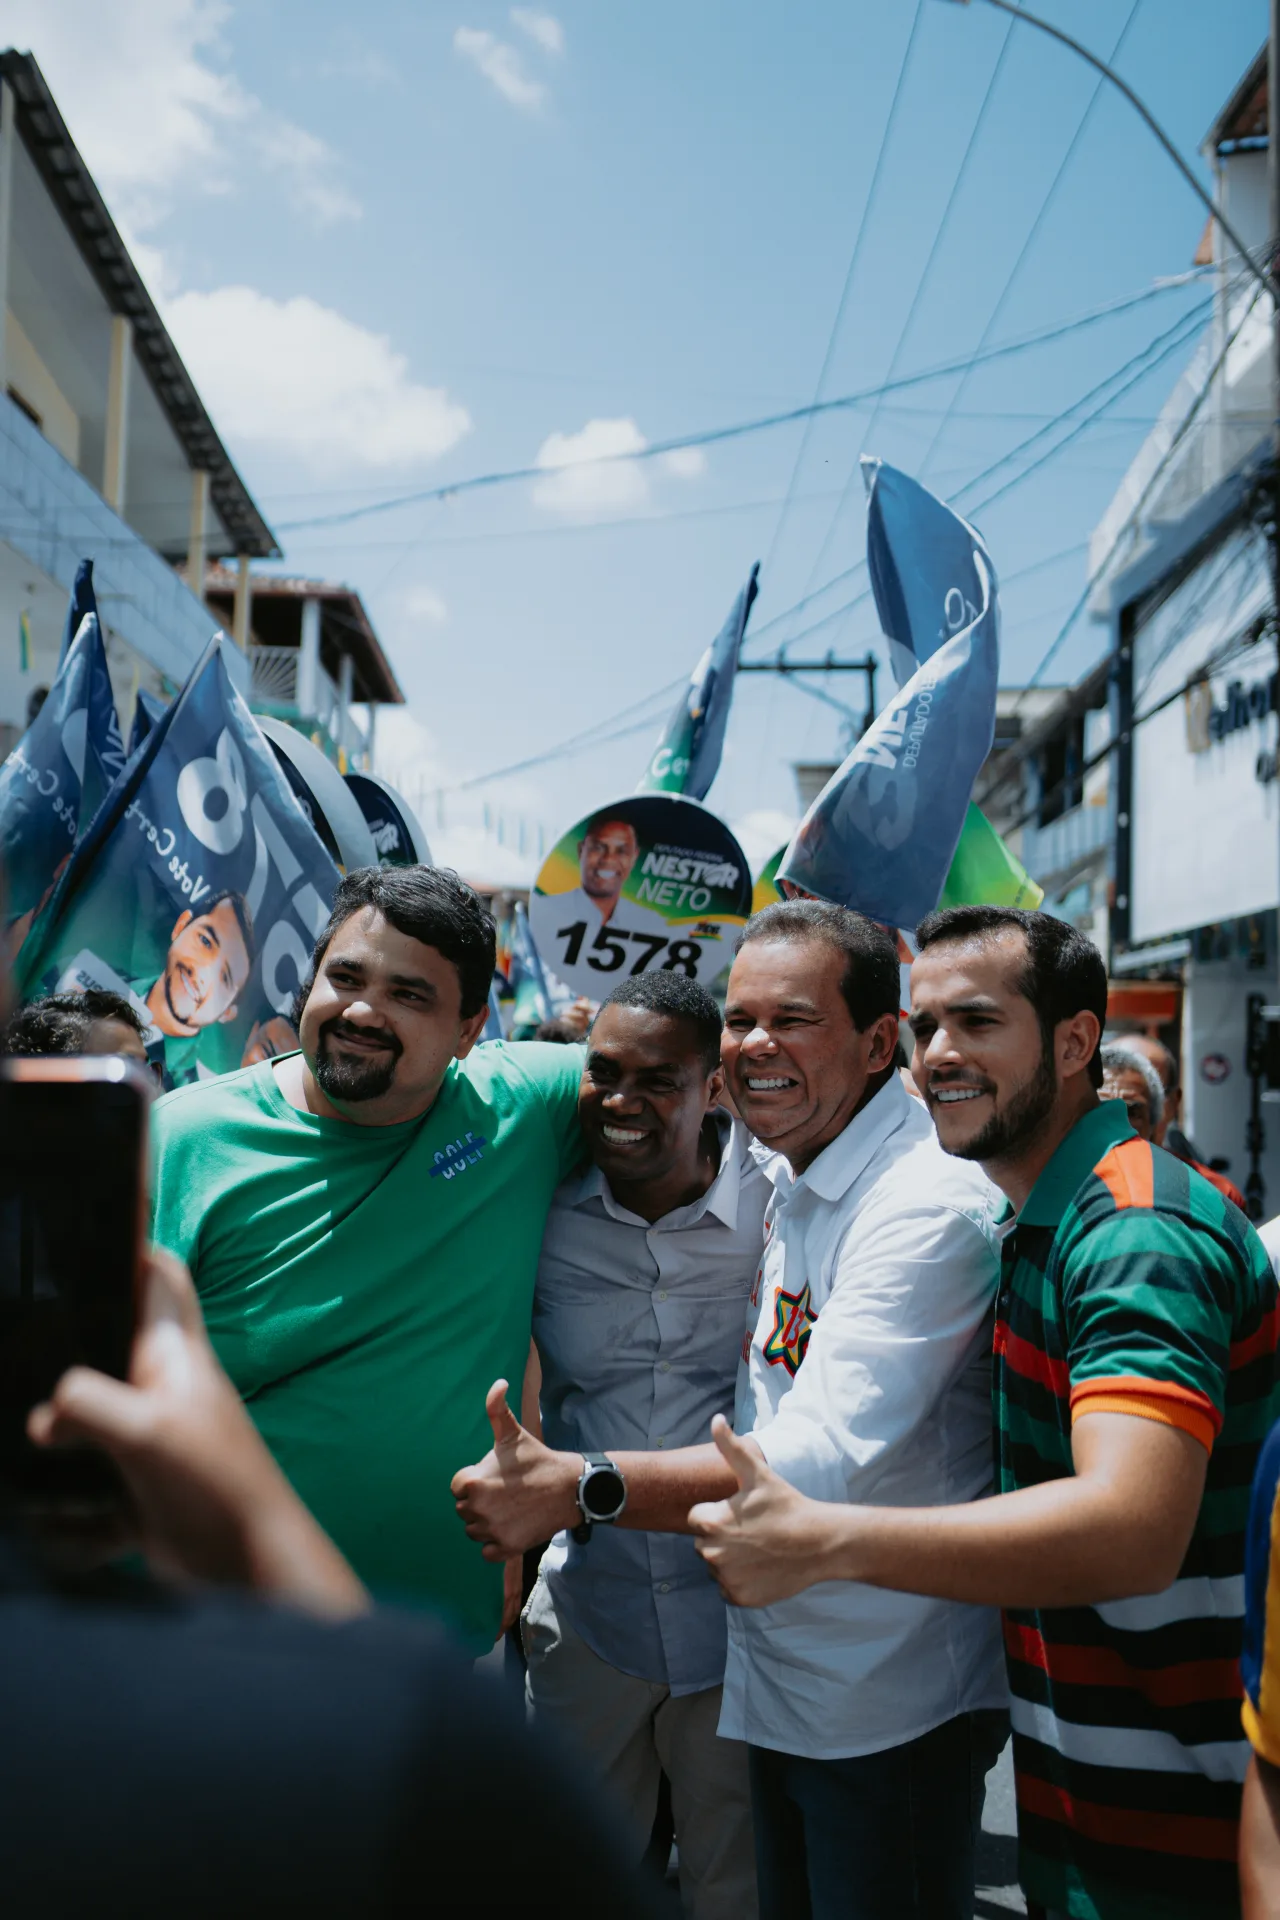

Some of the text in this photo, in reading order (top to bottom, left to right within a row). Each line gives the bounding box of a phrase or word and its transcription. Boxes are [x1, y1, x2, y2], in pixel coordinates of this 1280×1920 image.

[641, 851, 740, 890] NESTOR
[636, 877, 712, 912] NETO
[556, 920, 702, 979] 1578
